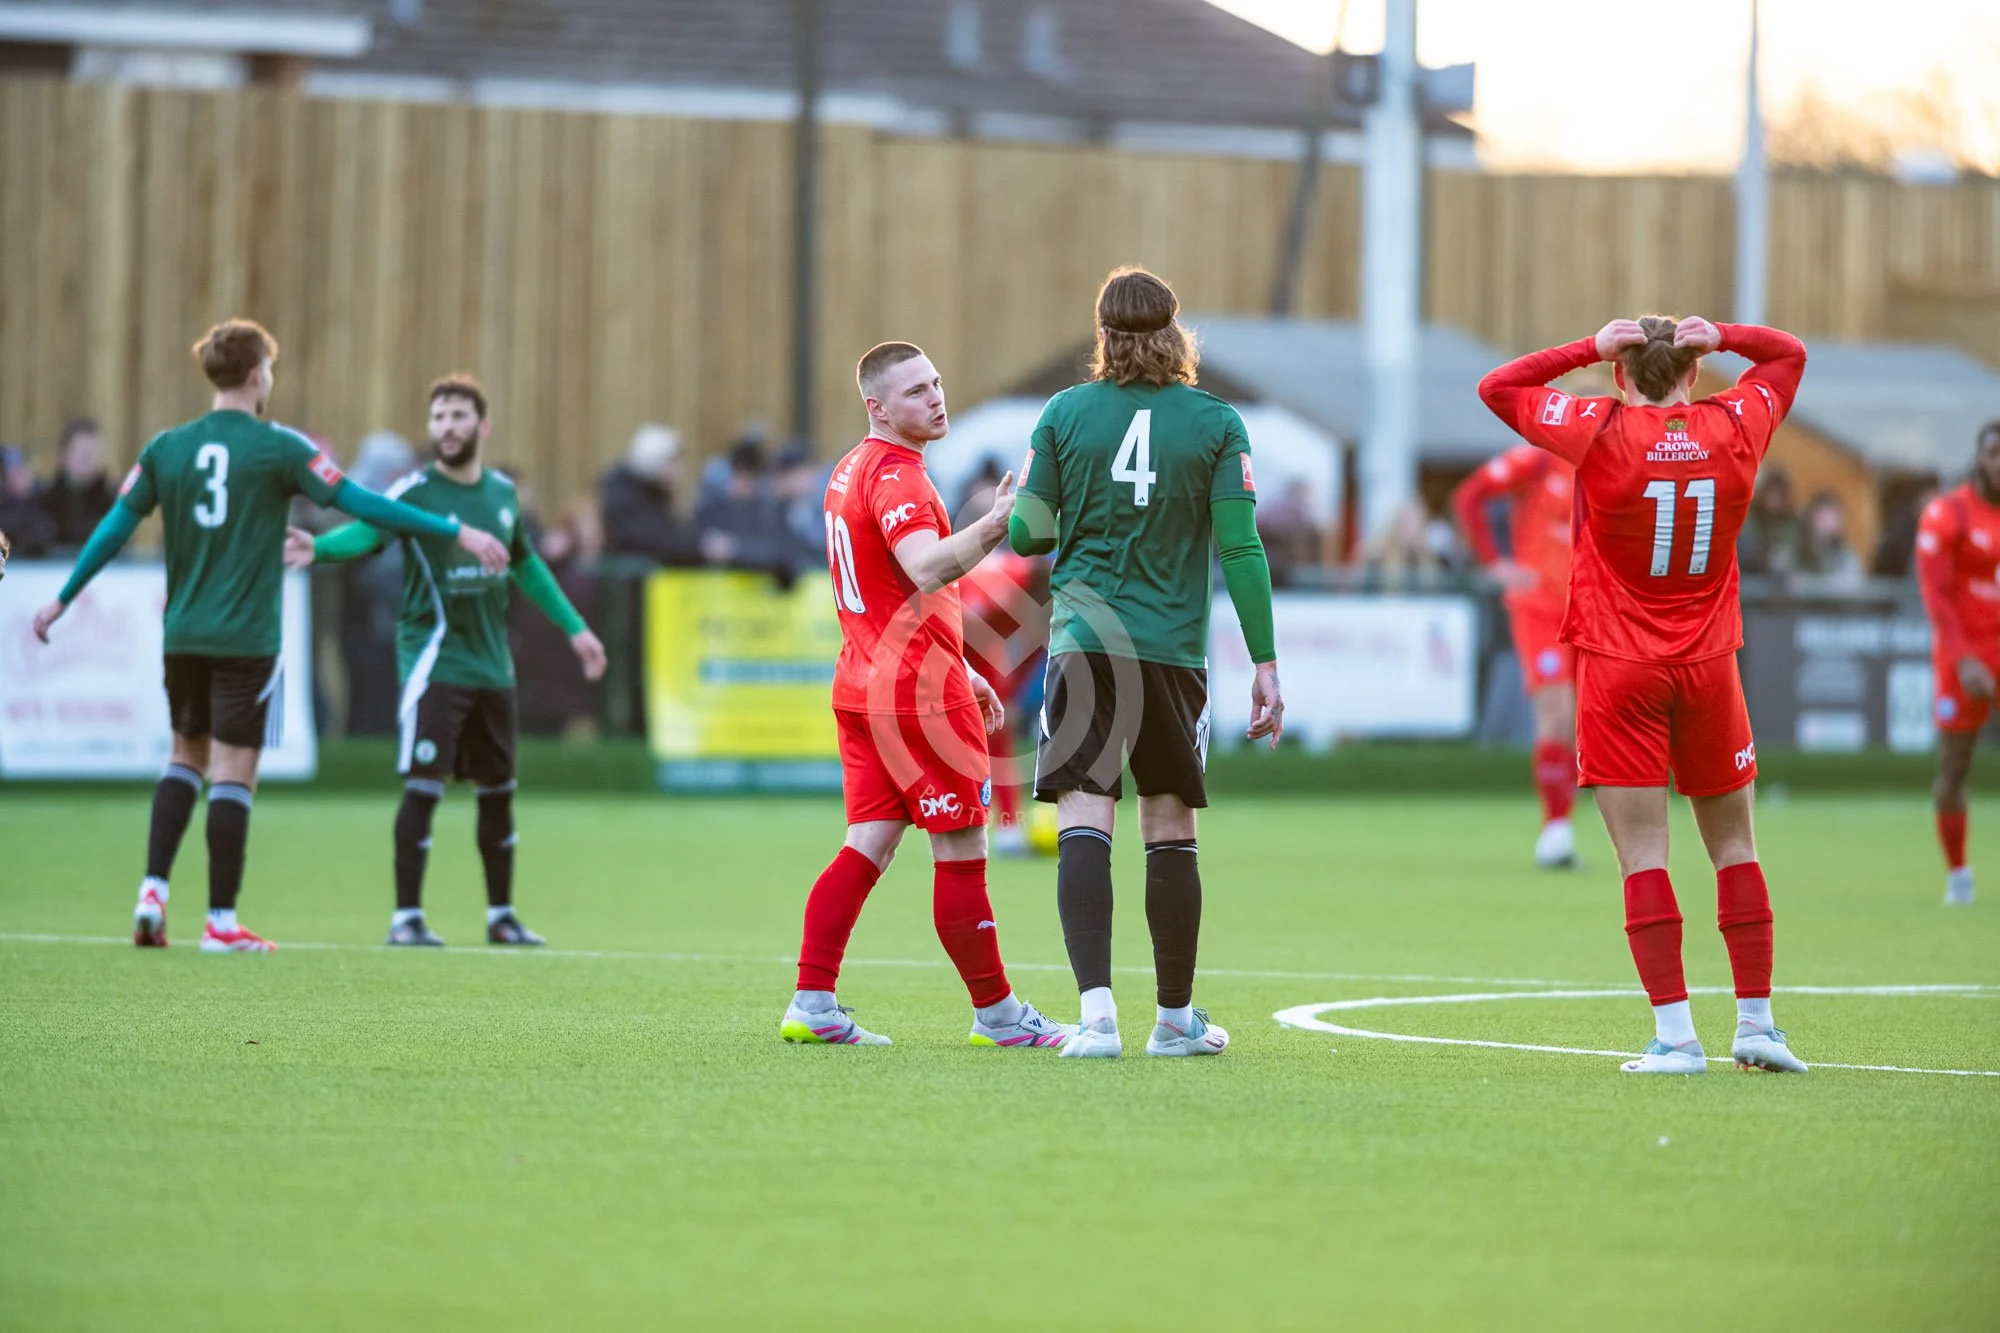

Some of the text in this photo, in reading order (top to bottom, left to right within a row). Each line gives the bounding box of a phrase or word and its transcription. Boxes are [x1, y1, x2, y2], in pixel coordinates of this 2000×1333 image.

[1655, 441, 1700, 452] CROWN
[1664, 431, 1689, 442] THE
[1110, 409, 1157, 507] 4
[1646, 450, 1710, 462] BILLERICAY
[194, 443, 230, 528] 3
[881, 502, 917, 533] DMC
[1642, 479, 1716, 577] 11
[919, 793, 960, 818] DMC
